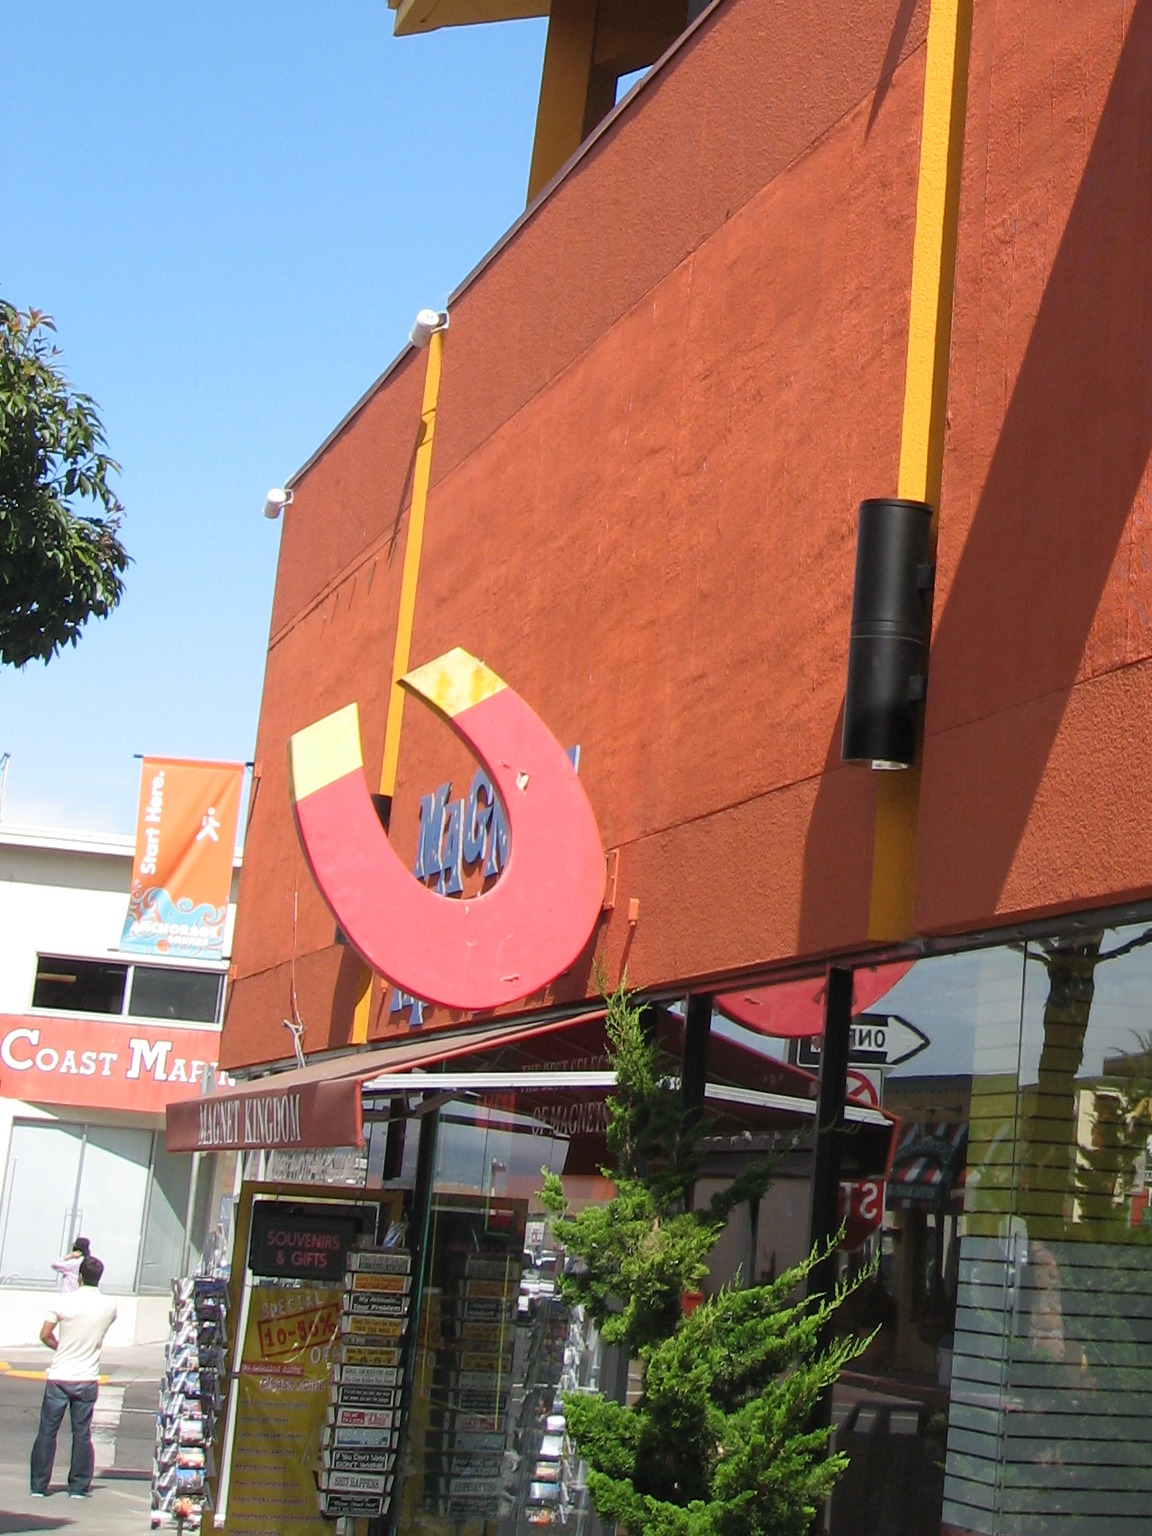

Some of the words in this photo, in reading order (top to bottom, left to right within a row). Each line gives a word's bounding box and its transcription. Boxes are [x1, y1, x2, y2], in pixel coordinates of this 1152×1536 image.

[140, 827, 161, 875] Start
[413, 766, 512, 898] MAGN
[0, 1027, 118, 1077] COAST
[198, 1099, 241, 1145] MAGNET
[244, 1094, 302, 1144] KINGDOM
[266, 1230, 340, 1250] SOUVENIRS
[291, 1252, 328, 1268] GIFTS
[261, 1292, 324, 1319] SPECIAL
